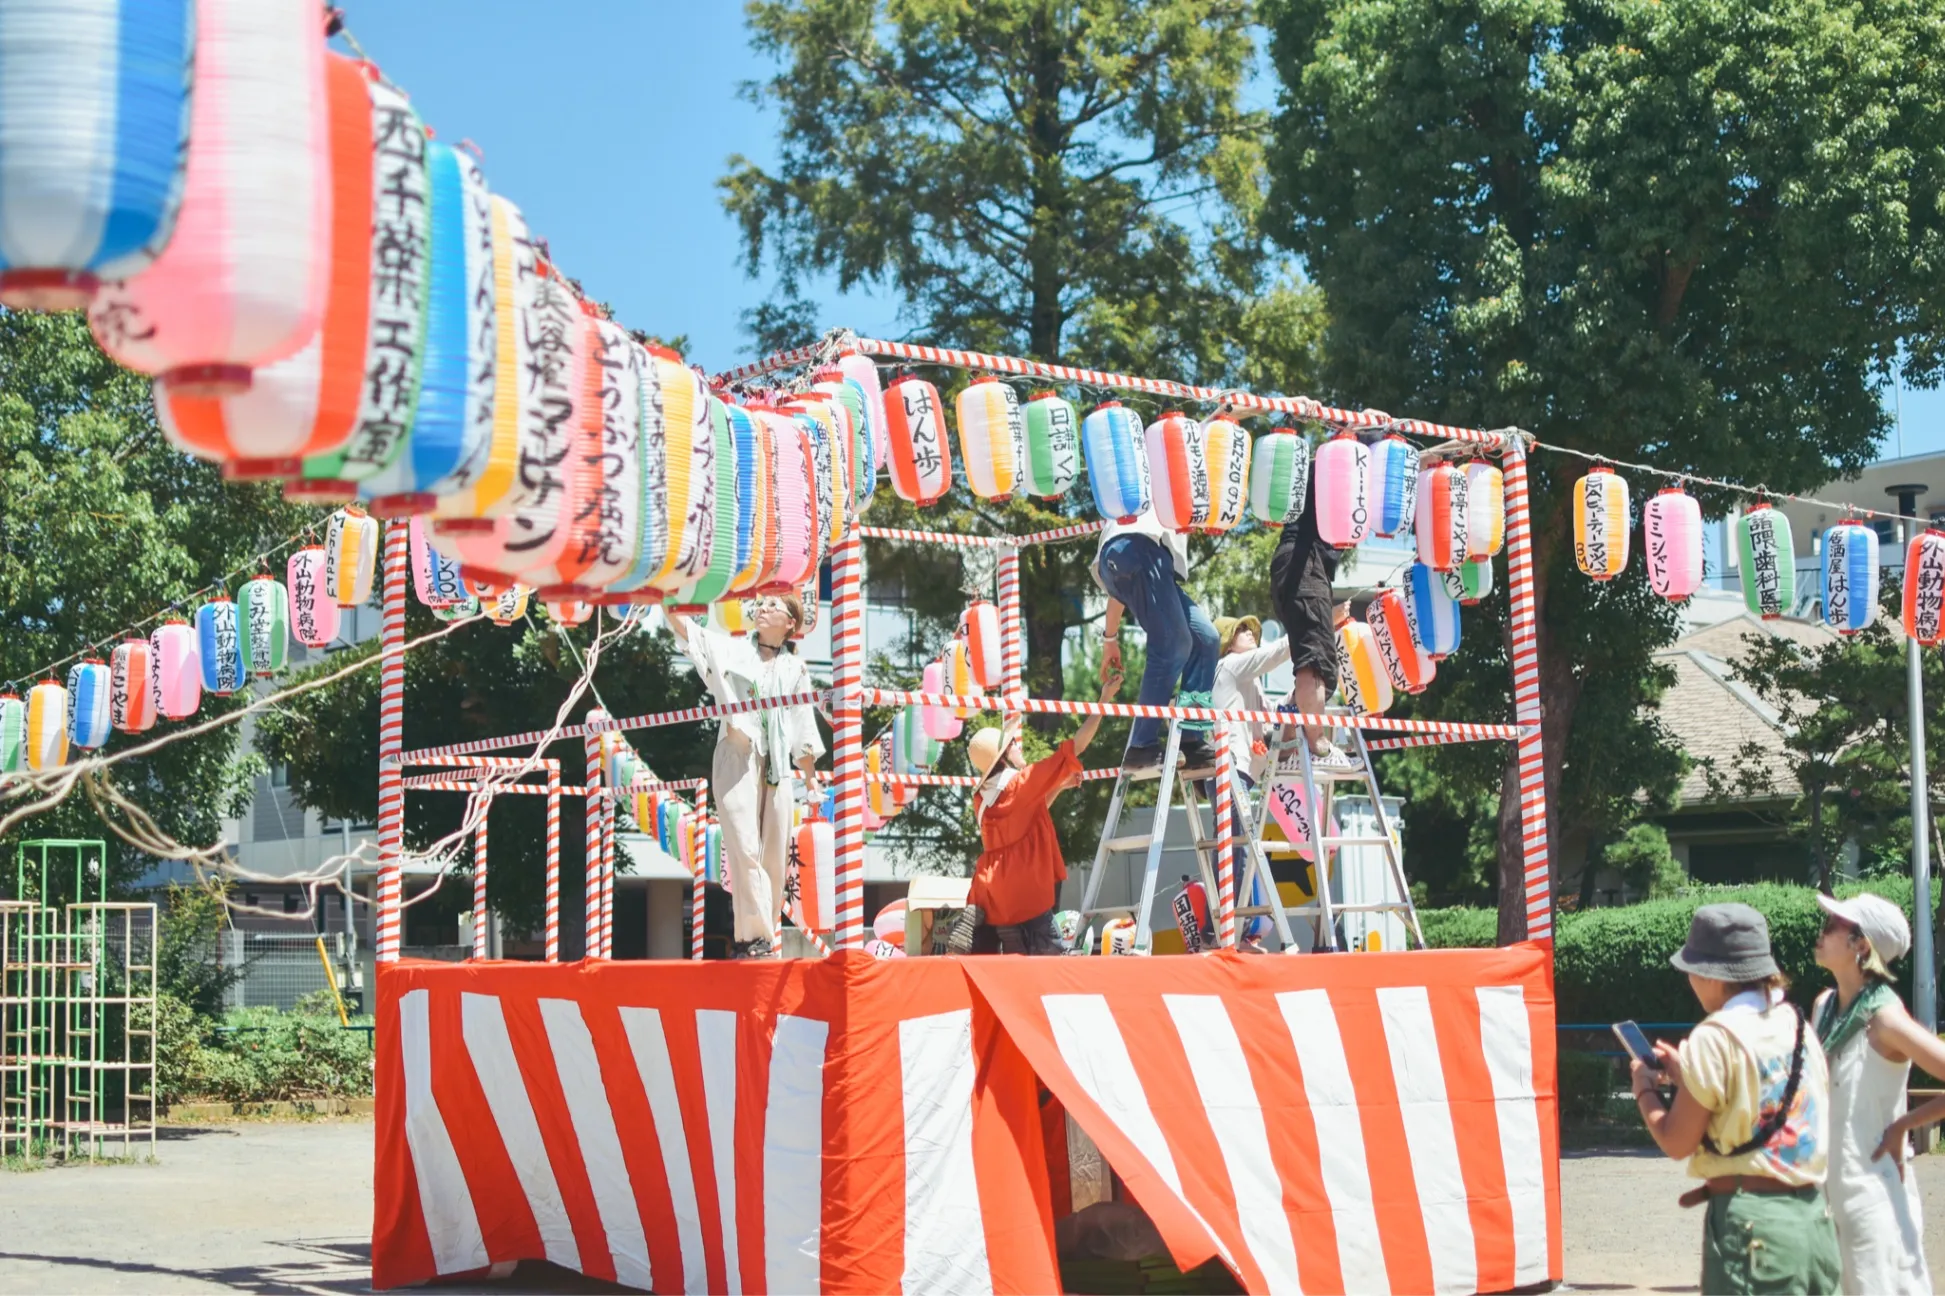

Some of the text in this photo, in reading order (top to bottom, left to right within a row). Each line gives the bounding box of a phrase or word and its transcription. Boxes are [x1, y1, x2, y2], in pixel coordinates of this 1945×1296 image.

[904, 389, 942, 478] はん歩
[1650, 502, 1671, 593] ミミシャトン
[1828, 530, 1850, 627] 居酒屋はん歩
[1915, 540, 1945, 640] 外山動物病院
[293, 552, 321, 641] 外山動物病院
[212, 604, 237, 690] 外山動物病院
